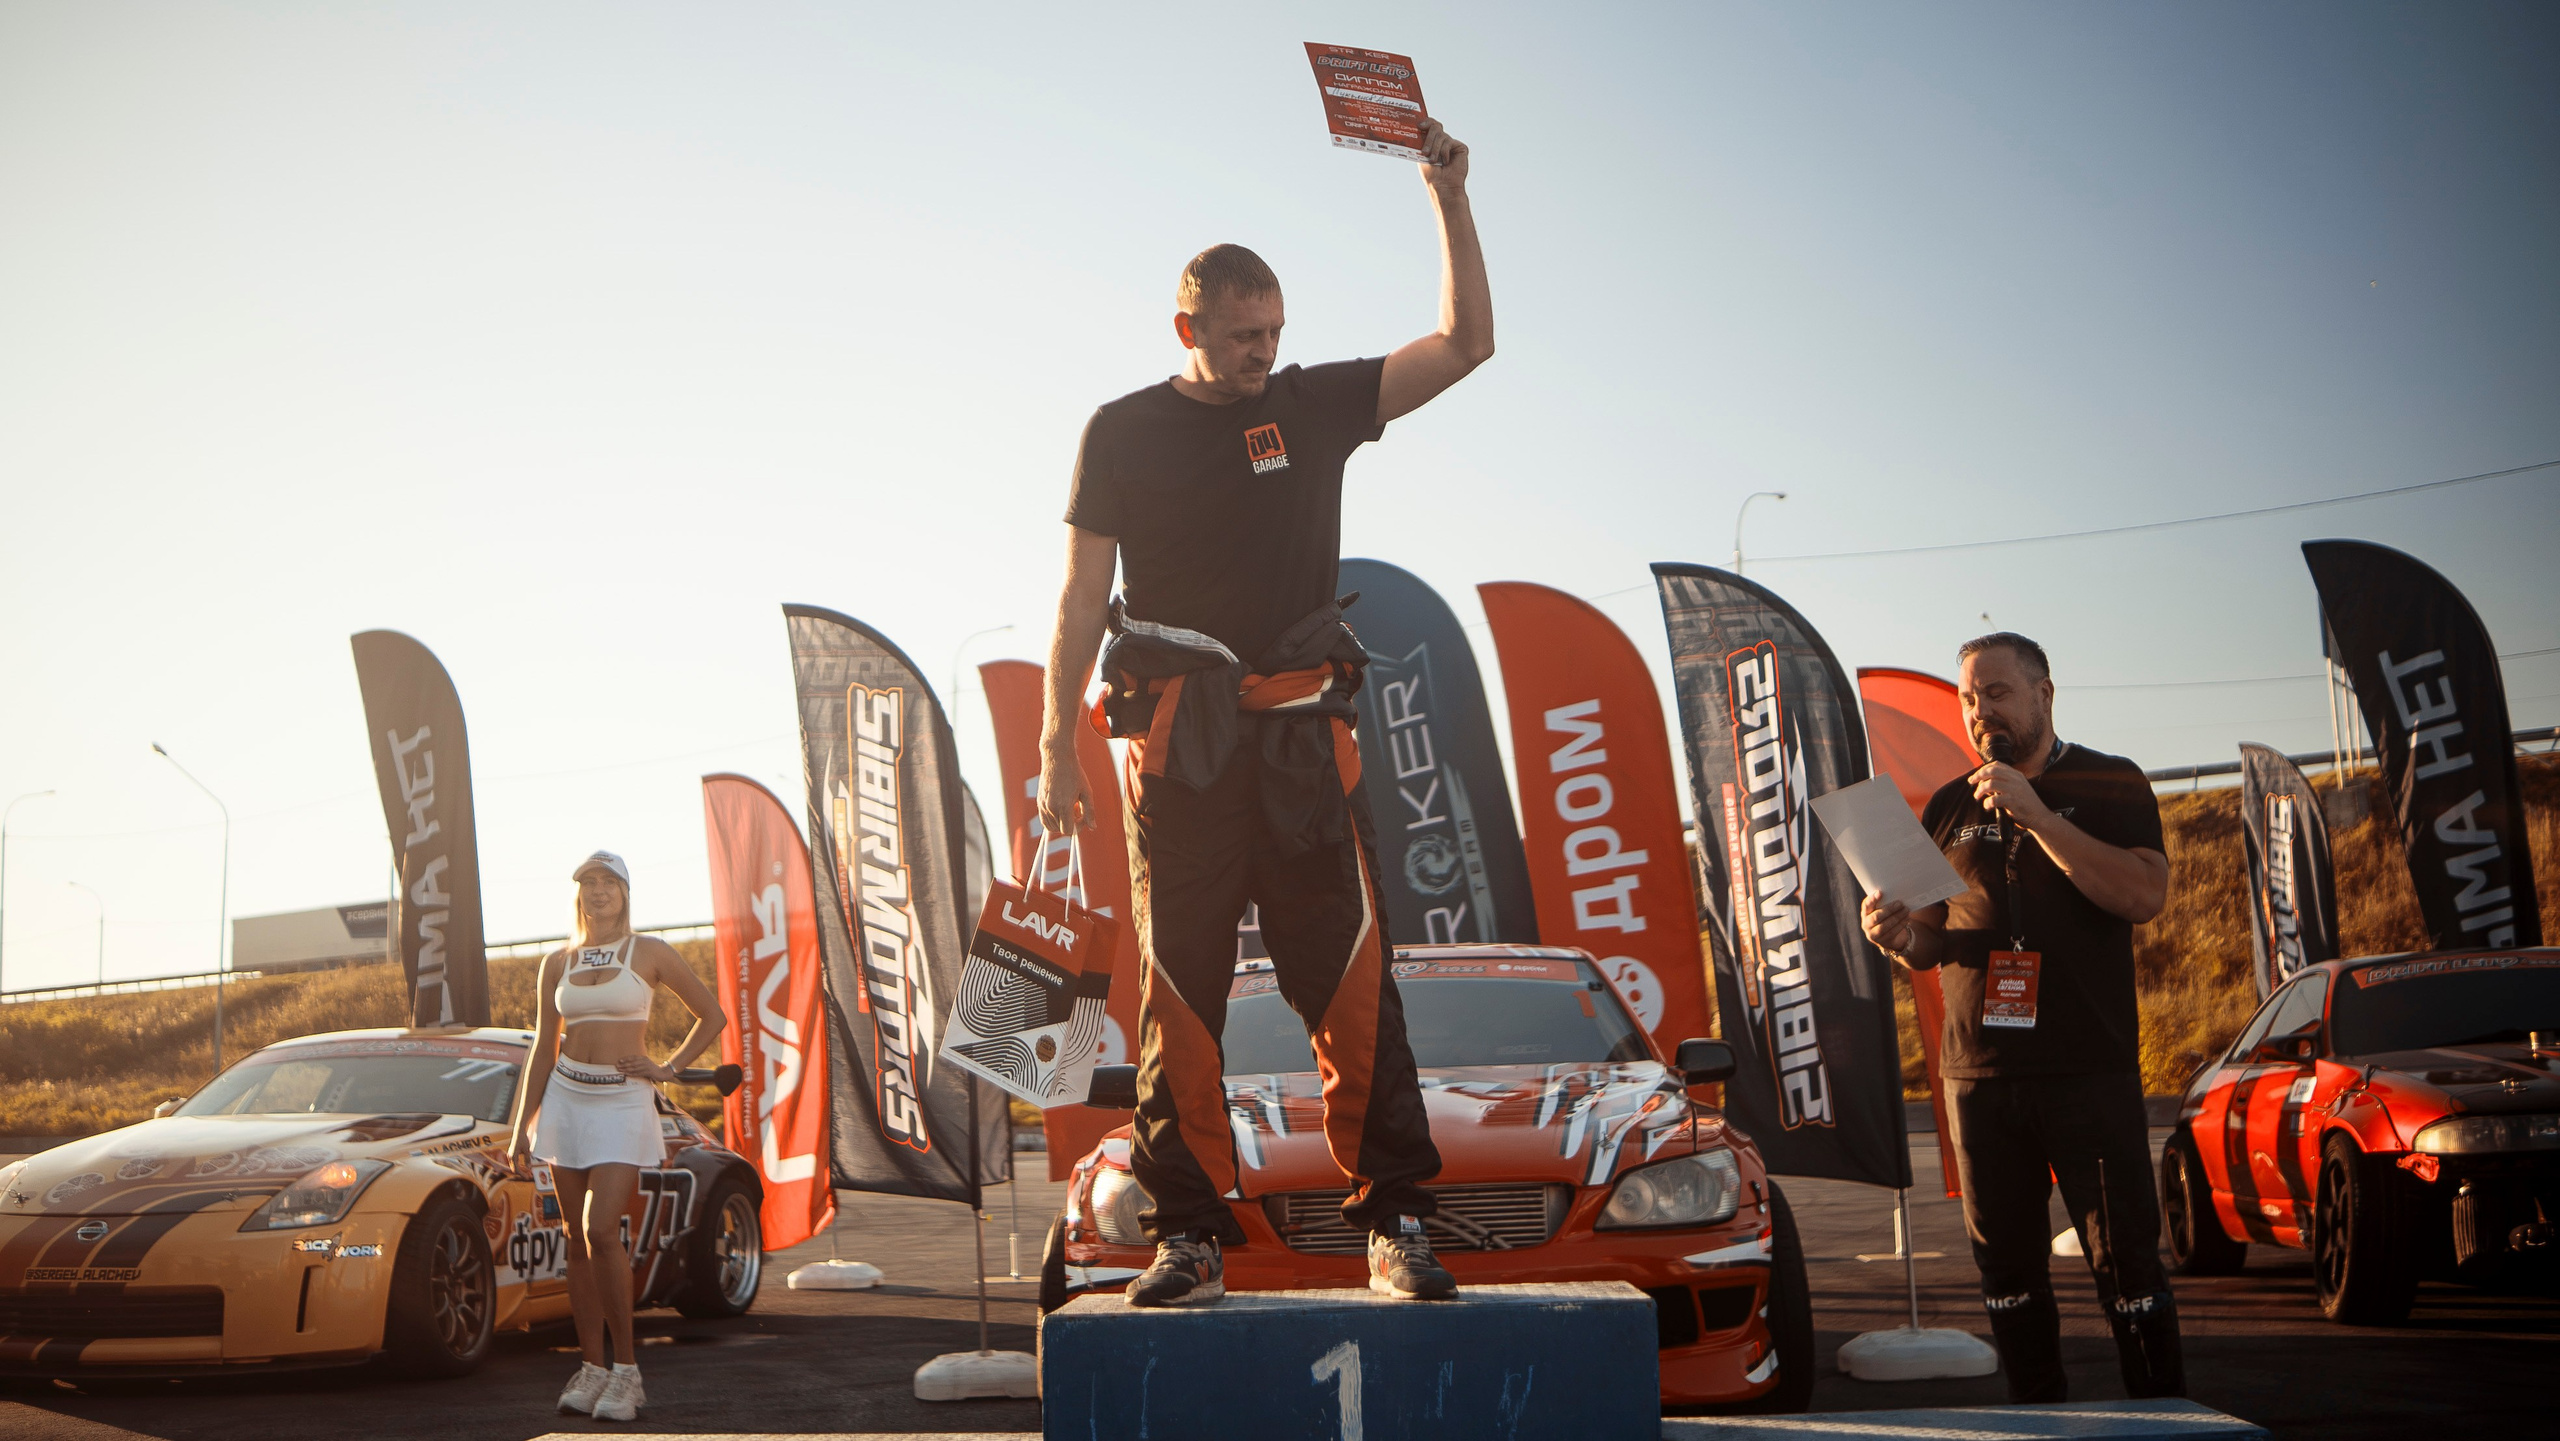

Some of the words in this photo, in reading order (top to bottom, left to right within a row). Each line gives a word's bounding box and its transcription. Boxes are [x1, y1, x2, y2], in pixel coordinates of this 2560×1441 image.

[1317, 55, 1367, 70] DRIFT
[1369, 63, 1412, 79] LETO
[1335, 73, 1403, 90] ДИПЛОМ
[1253, 454, 1289, 474] GARAGE
[2378, 650, 2473, 780] НЕТ
[387, 725, 441, 849] НЕТ
[1544, 698, 1649, 934] дром
[1002, 900, 1076, 951] LAVR
[582, 950, 614, 967] SM
[992, 943, 1018, 962] Твое
[1020, 957, 1063, 986] решение
[439, 1057, 513, 1082] 77
[638, 1168, 698, 1300] 77
[292, 1239, 332, 1252] RACE
[334, 1244, 384, 1258] WORK
[25, 1268, 142, 1281] @SERGEY_ALACHEV
[2114, 1296, 2154, 1314] OFF
[1312, 1340, 1363, 1441] 1
